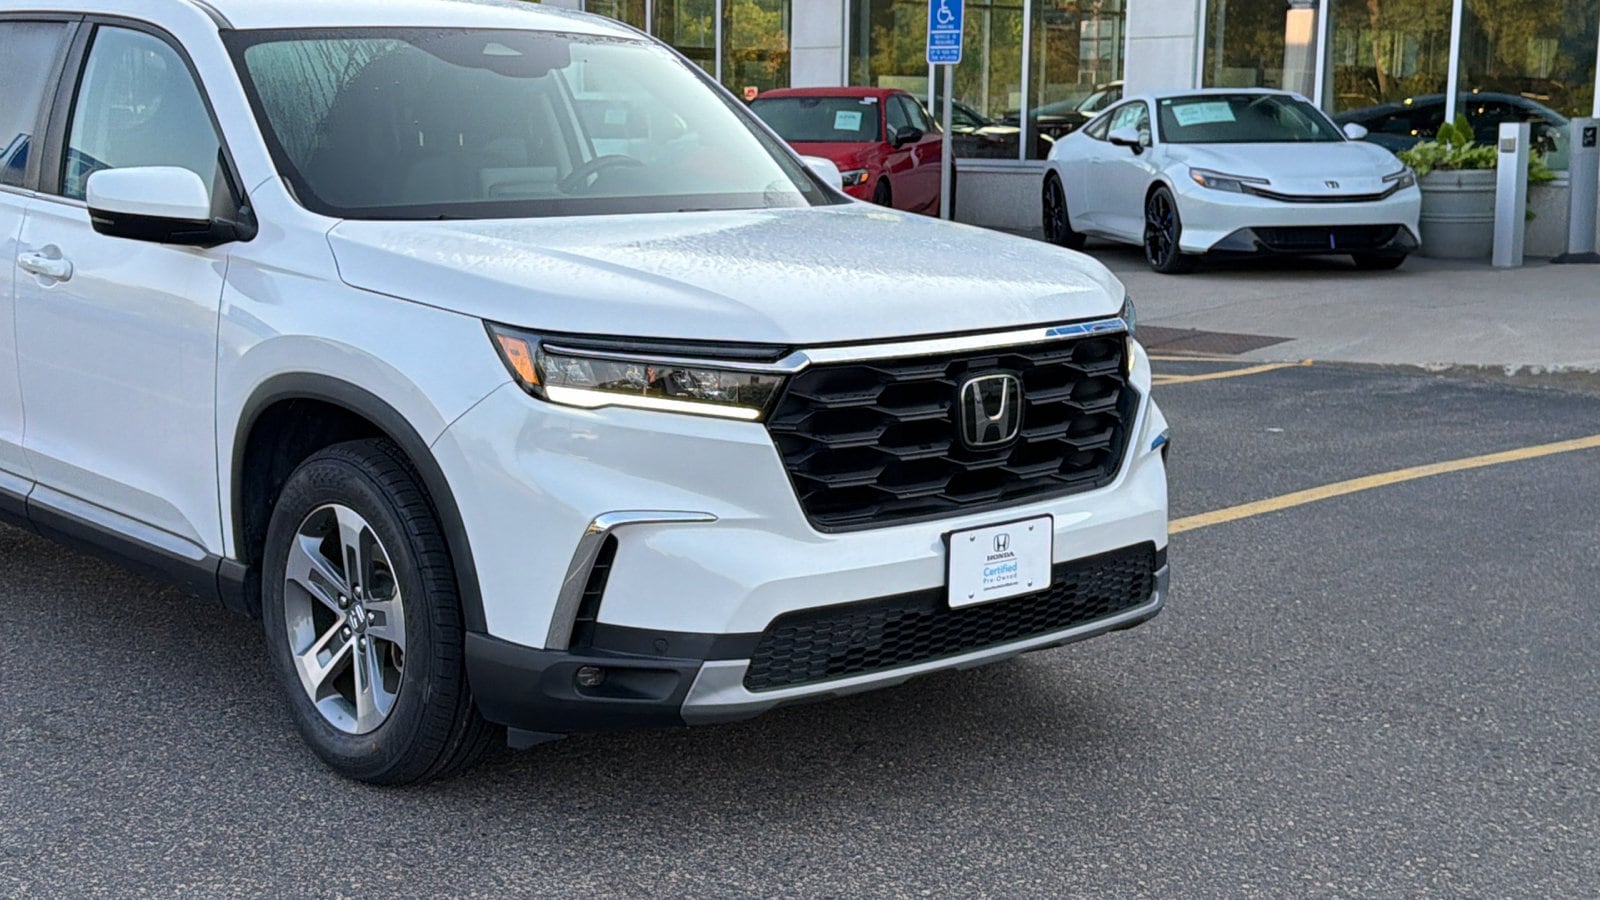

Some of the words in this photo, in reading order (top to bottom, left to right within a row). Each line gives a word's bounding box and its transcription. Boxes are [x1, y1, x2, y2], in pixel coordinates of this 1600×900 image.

[986, 551, 1015, 561] HONDA
[983, 561, 1018, 577] Certified
[983, 573, 1017, 584] Pre-Owned
